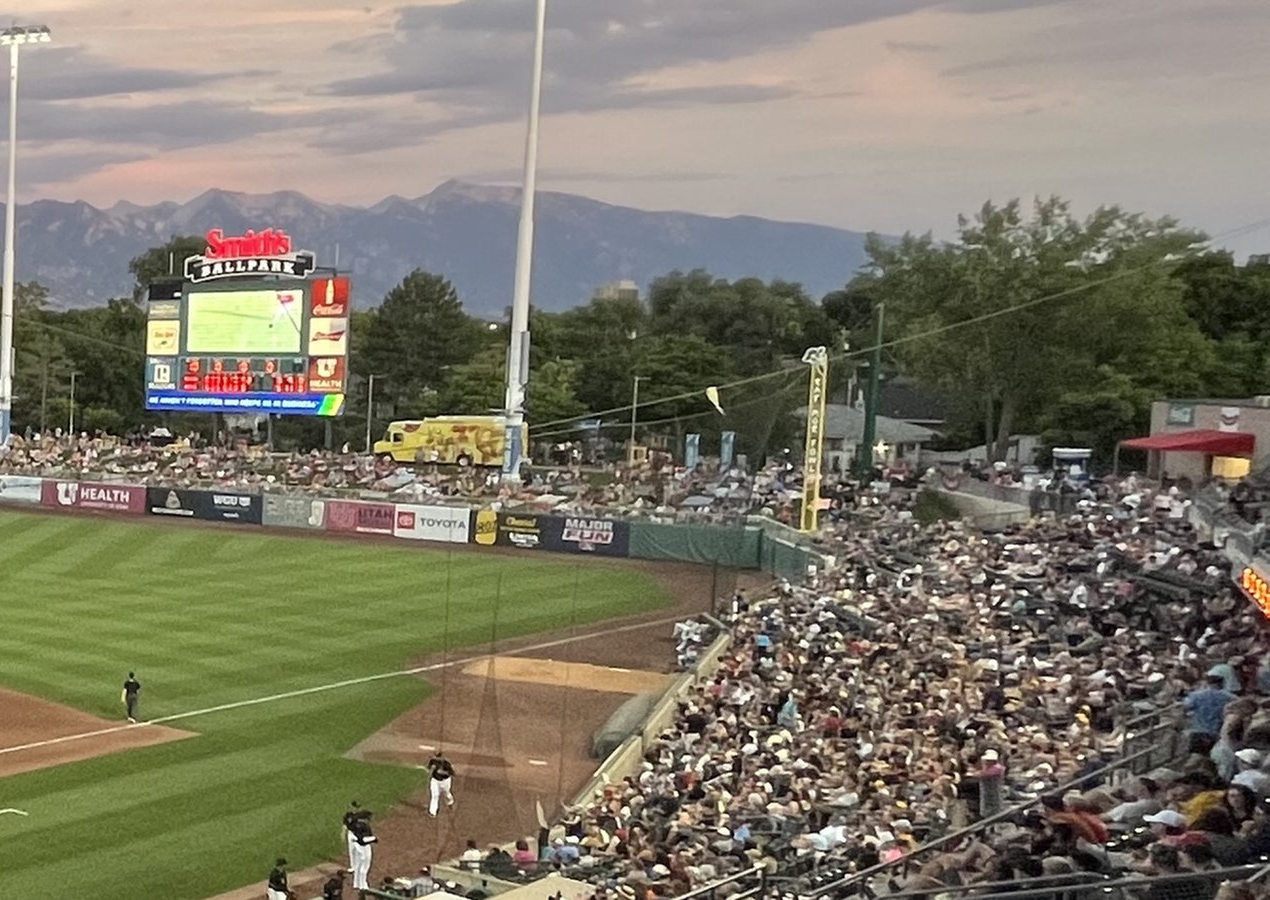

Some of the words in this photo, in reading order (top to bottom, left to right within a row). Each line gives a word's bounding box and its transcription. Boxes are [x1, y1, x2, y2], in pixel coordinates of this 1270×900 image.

[205, 228, 291, 258] Smith's
[201, 259, 295, 277] BALLPARK
[80, 487, 130, 503] HEALTH
[420, 517, 466, 529] TOYOTA
[565, 518, 613, 530] MAJOR
[566, 530, 610, 541] FUN
